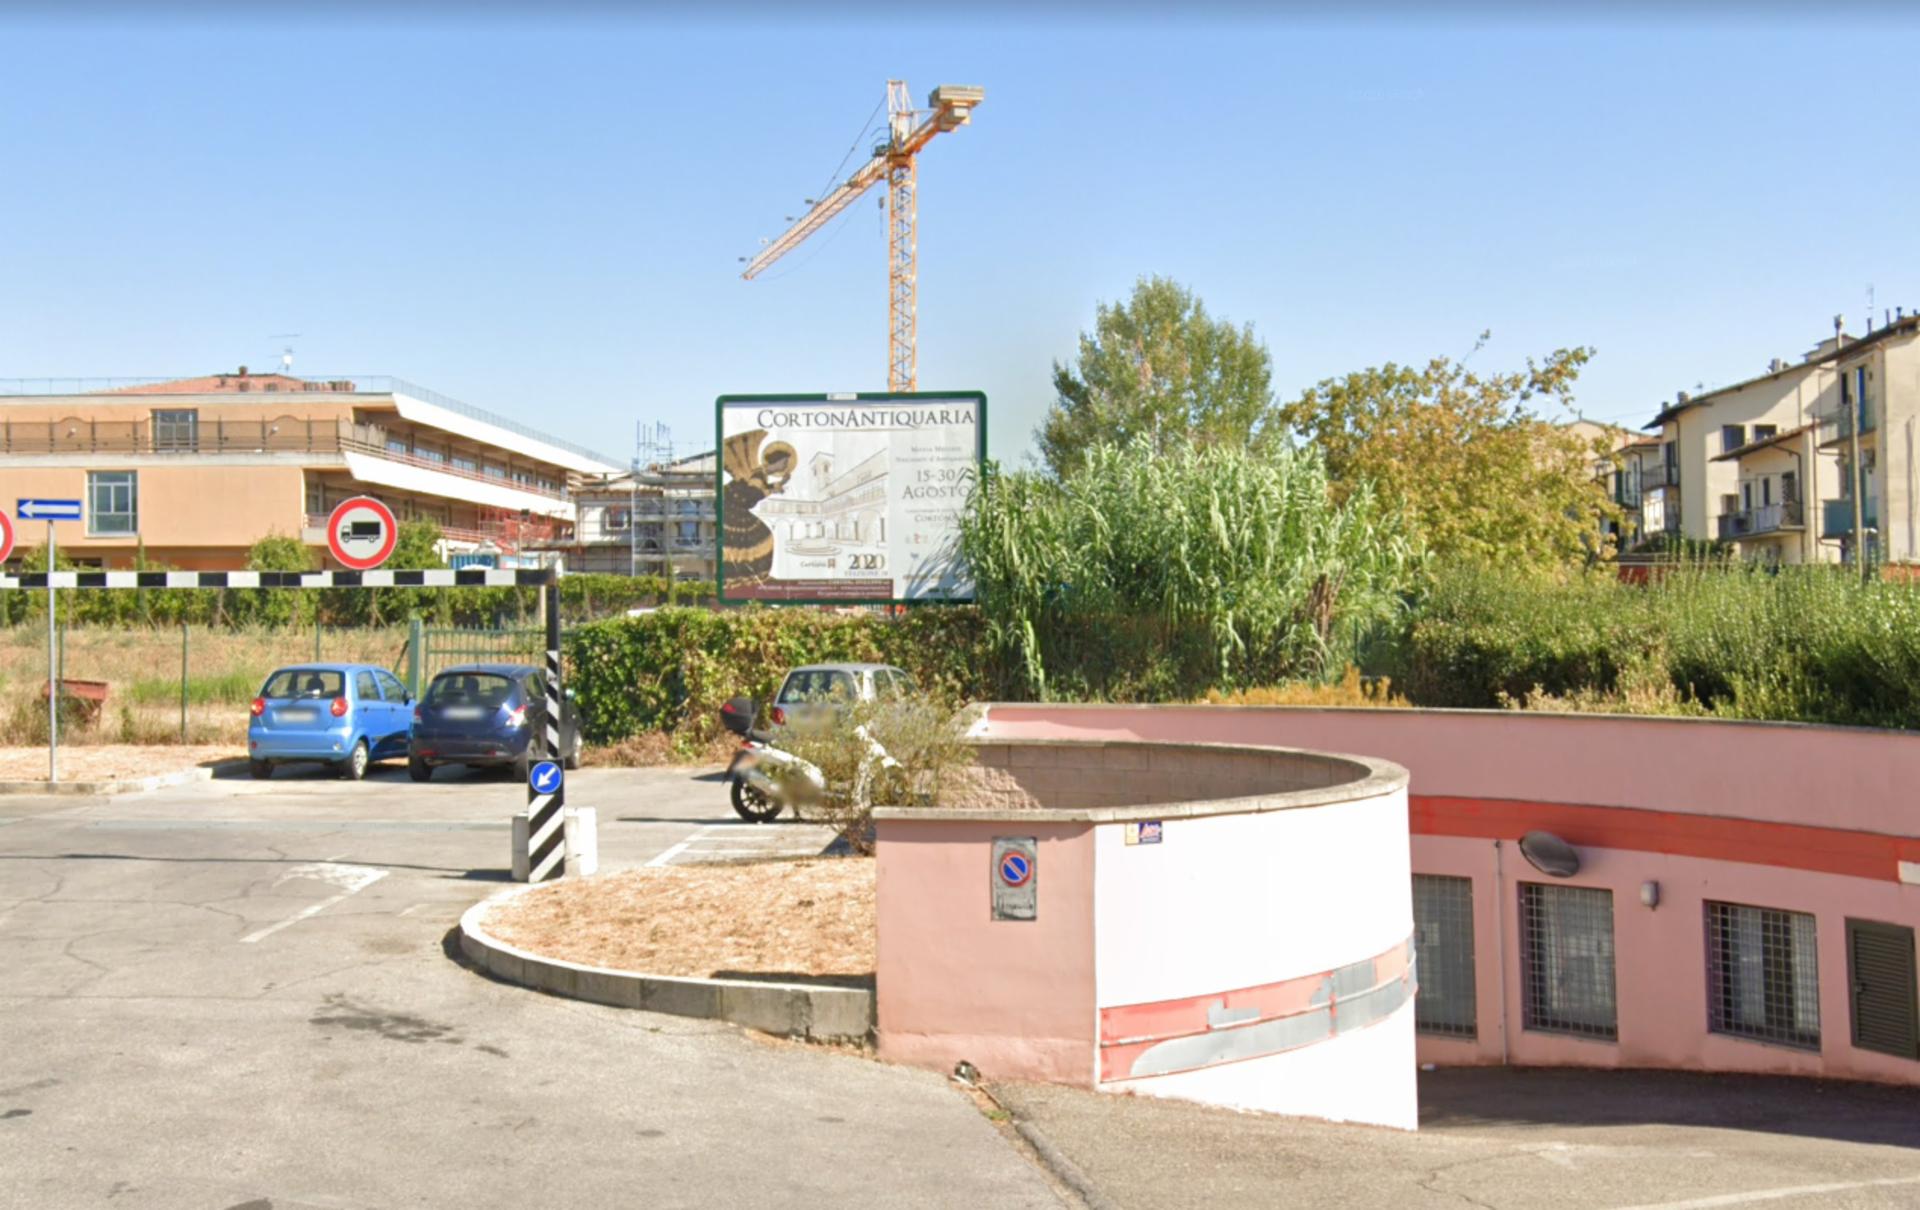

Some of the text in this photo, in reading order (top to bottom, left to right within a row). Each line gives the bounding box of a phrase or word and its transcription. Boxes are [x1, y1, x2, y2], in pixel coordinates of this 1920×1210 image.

[757, 408, 975, 429] CORTONANTIQUARIA
[916, 468, 956, 482] 15-30
[902, 485, 971, 500] AGOSTO
[848, 553, 886, 570] 2020
